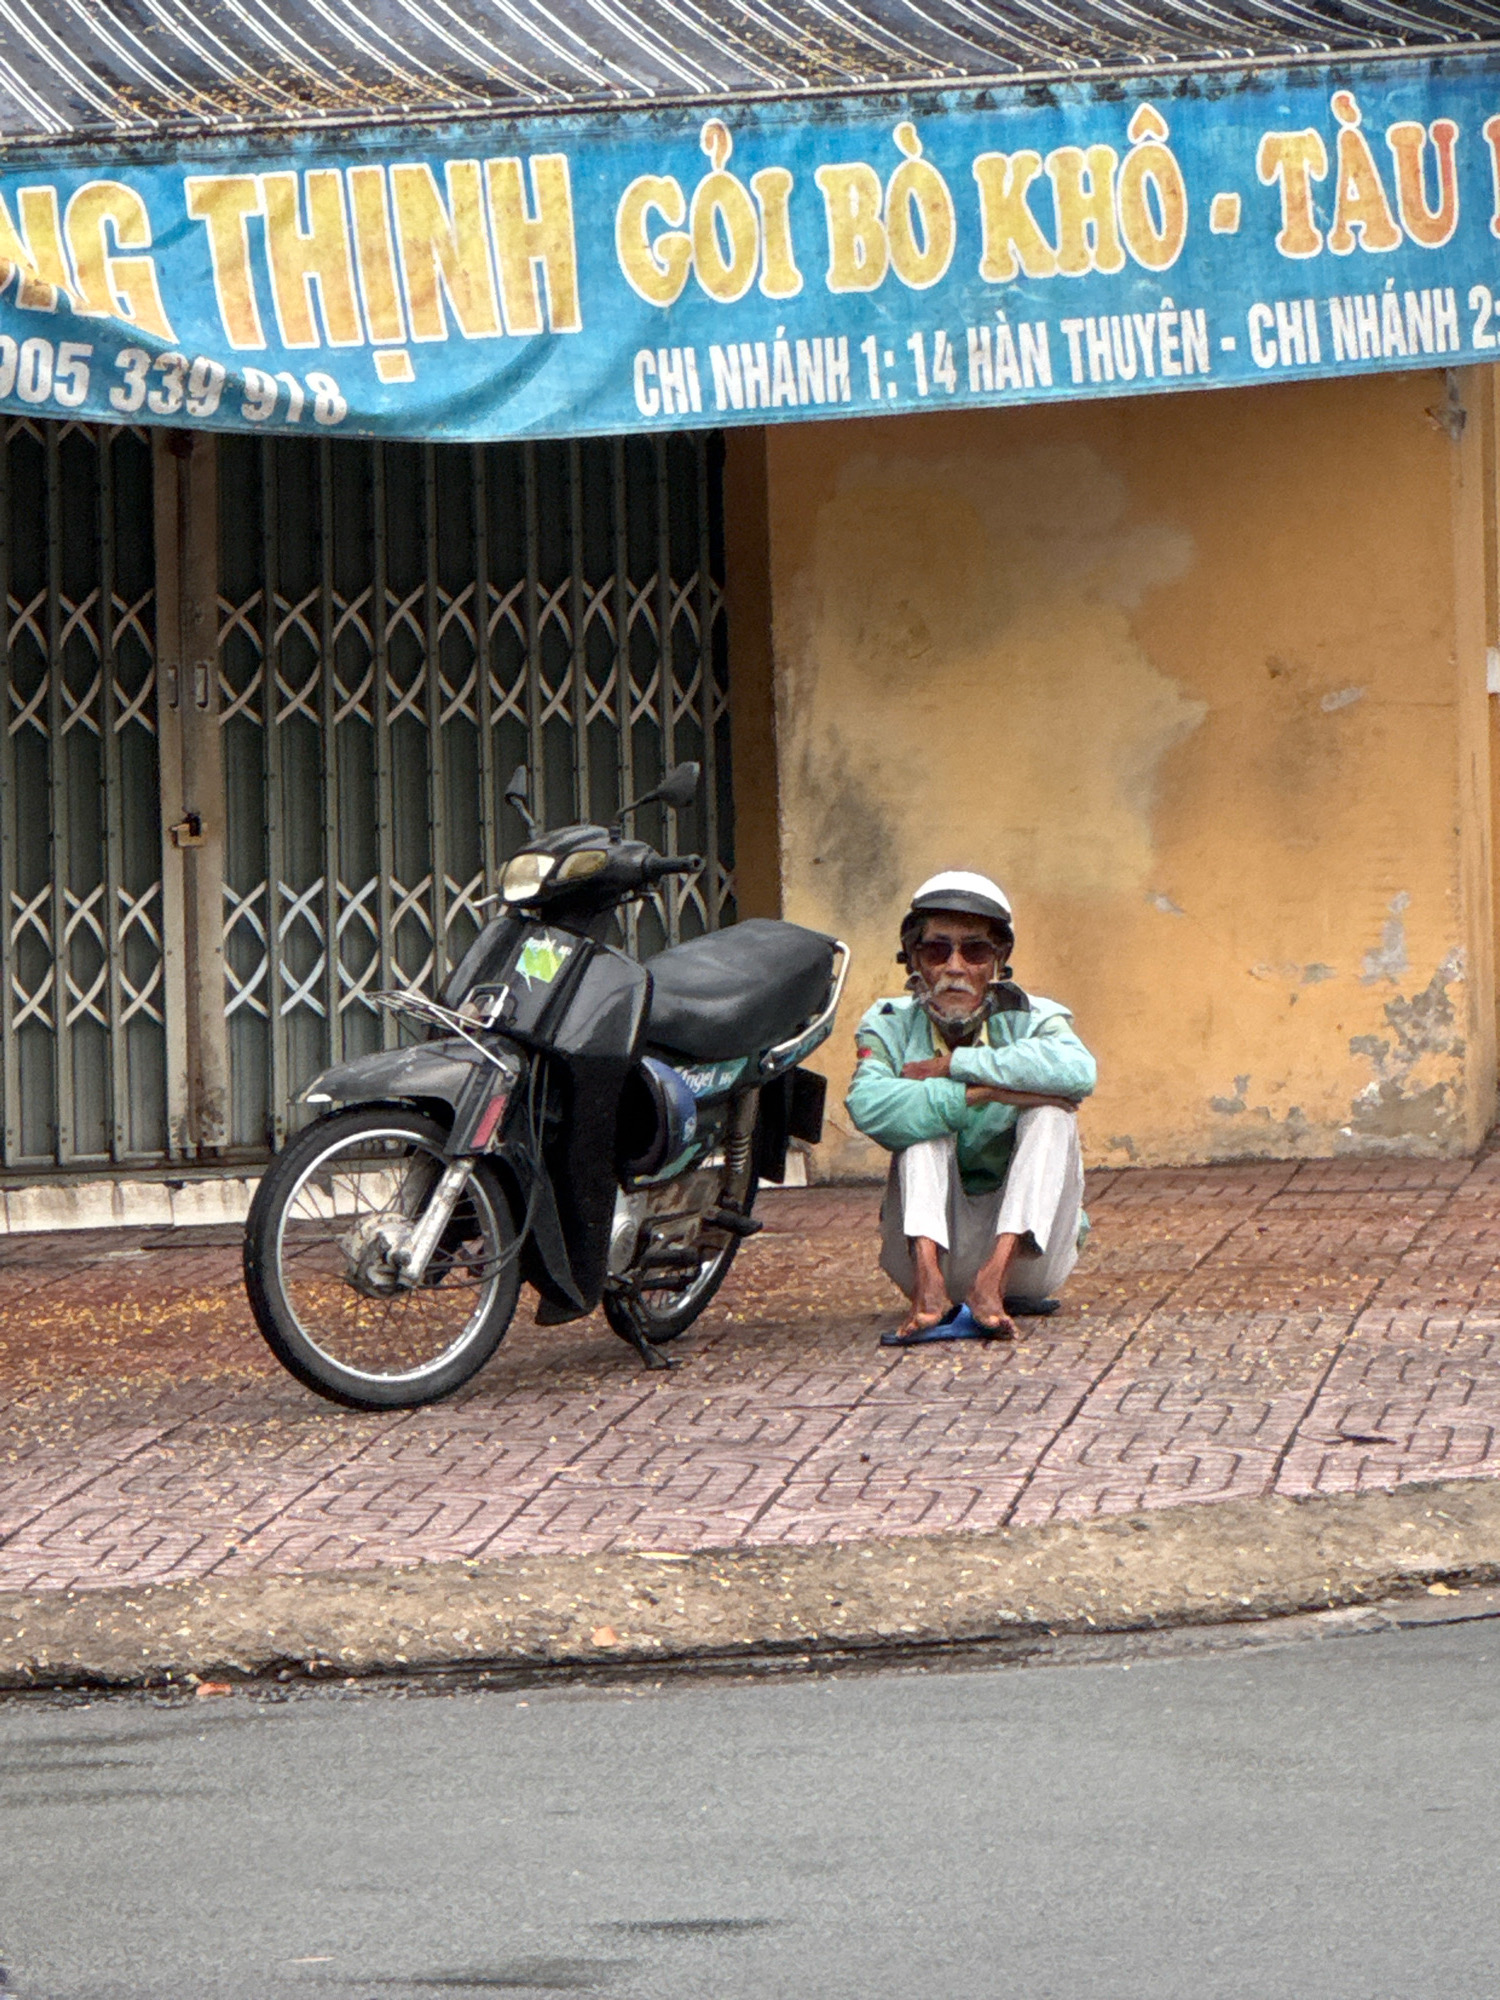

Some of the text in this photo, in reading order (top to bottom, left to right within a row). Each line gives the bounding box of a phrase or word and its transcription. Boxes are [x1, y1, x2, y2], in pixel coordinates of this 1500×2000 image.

[0, 153, 582, 384] NG THỊNH
[615, 118, 803, 307] GỎI
[815, 122, 956, 293] BÒ
[973, 102, 1188, 284] KHÔ
[1257, 90, 1459, 259] TÀU
[110, 347, 226, 418] 339
[241, 367, 348, 425] 918
[633, 347, 702, 416] CHI
[709, 325, 851, 412] NHÁNH
[966, 310, 1053, 392] HÀN
[1060, 297, 1210, 384] THUYÊN
[1248, 299, 1321, 369] CHI
[1328, 278, 1460, 361] NHÁNH
